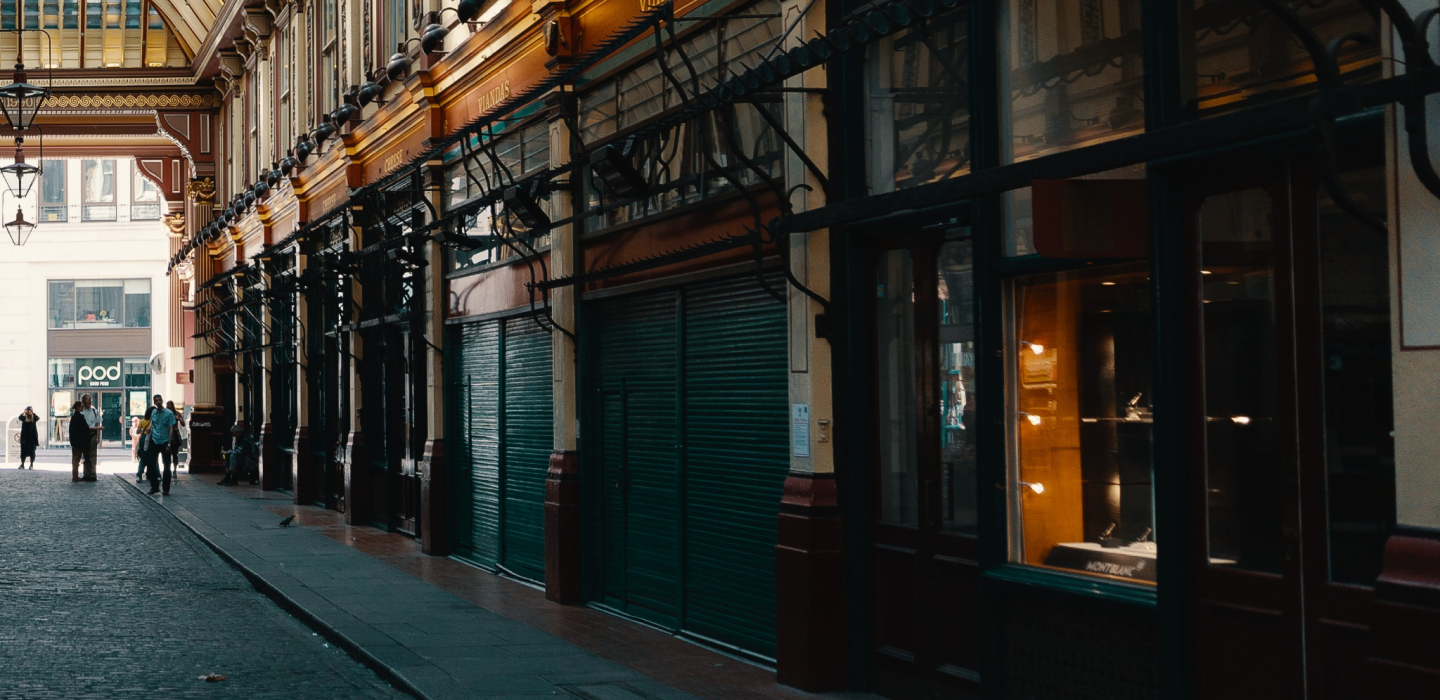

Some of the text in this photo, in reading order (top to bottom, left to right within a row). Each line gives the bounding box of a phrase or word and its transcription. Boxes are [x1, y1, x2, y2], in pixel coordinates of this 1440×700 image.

[478, 80, 510, 113] VIANDAS
[78, 361, 120, 385] pod
[1086, 561, 1136, 577] MONTBLANC
